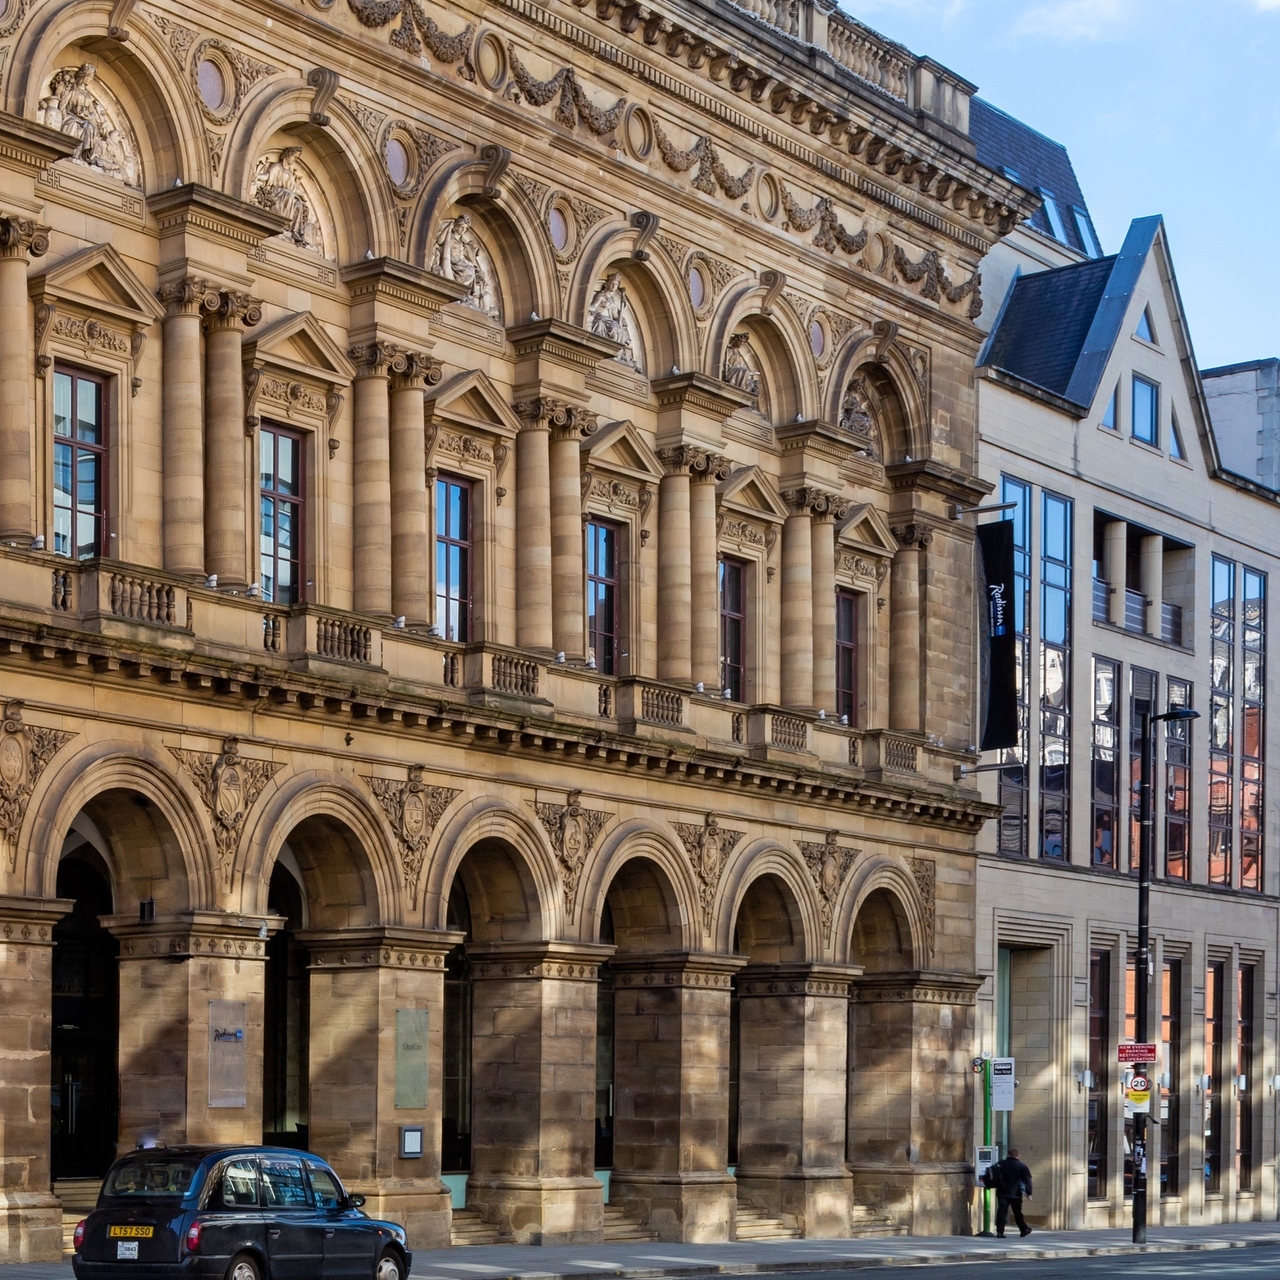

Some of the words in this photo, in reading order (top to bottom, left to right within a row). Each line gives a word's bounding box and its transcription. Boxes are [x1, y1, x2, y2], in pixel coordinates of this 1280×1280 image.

[989, 583, 1007, 626] Radisson
[1133, 1080, 1146, 1088] 20
[113, 1226, 133, 1236] LT57
